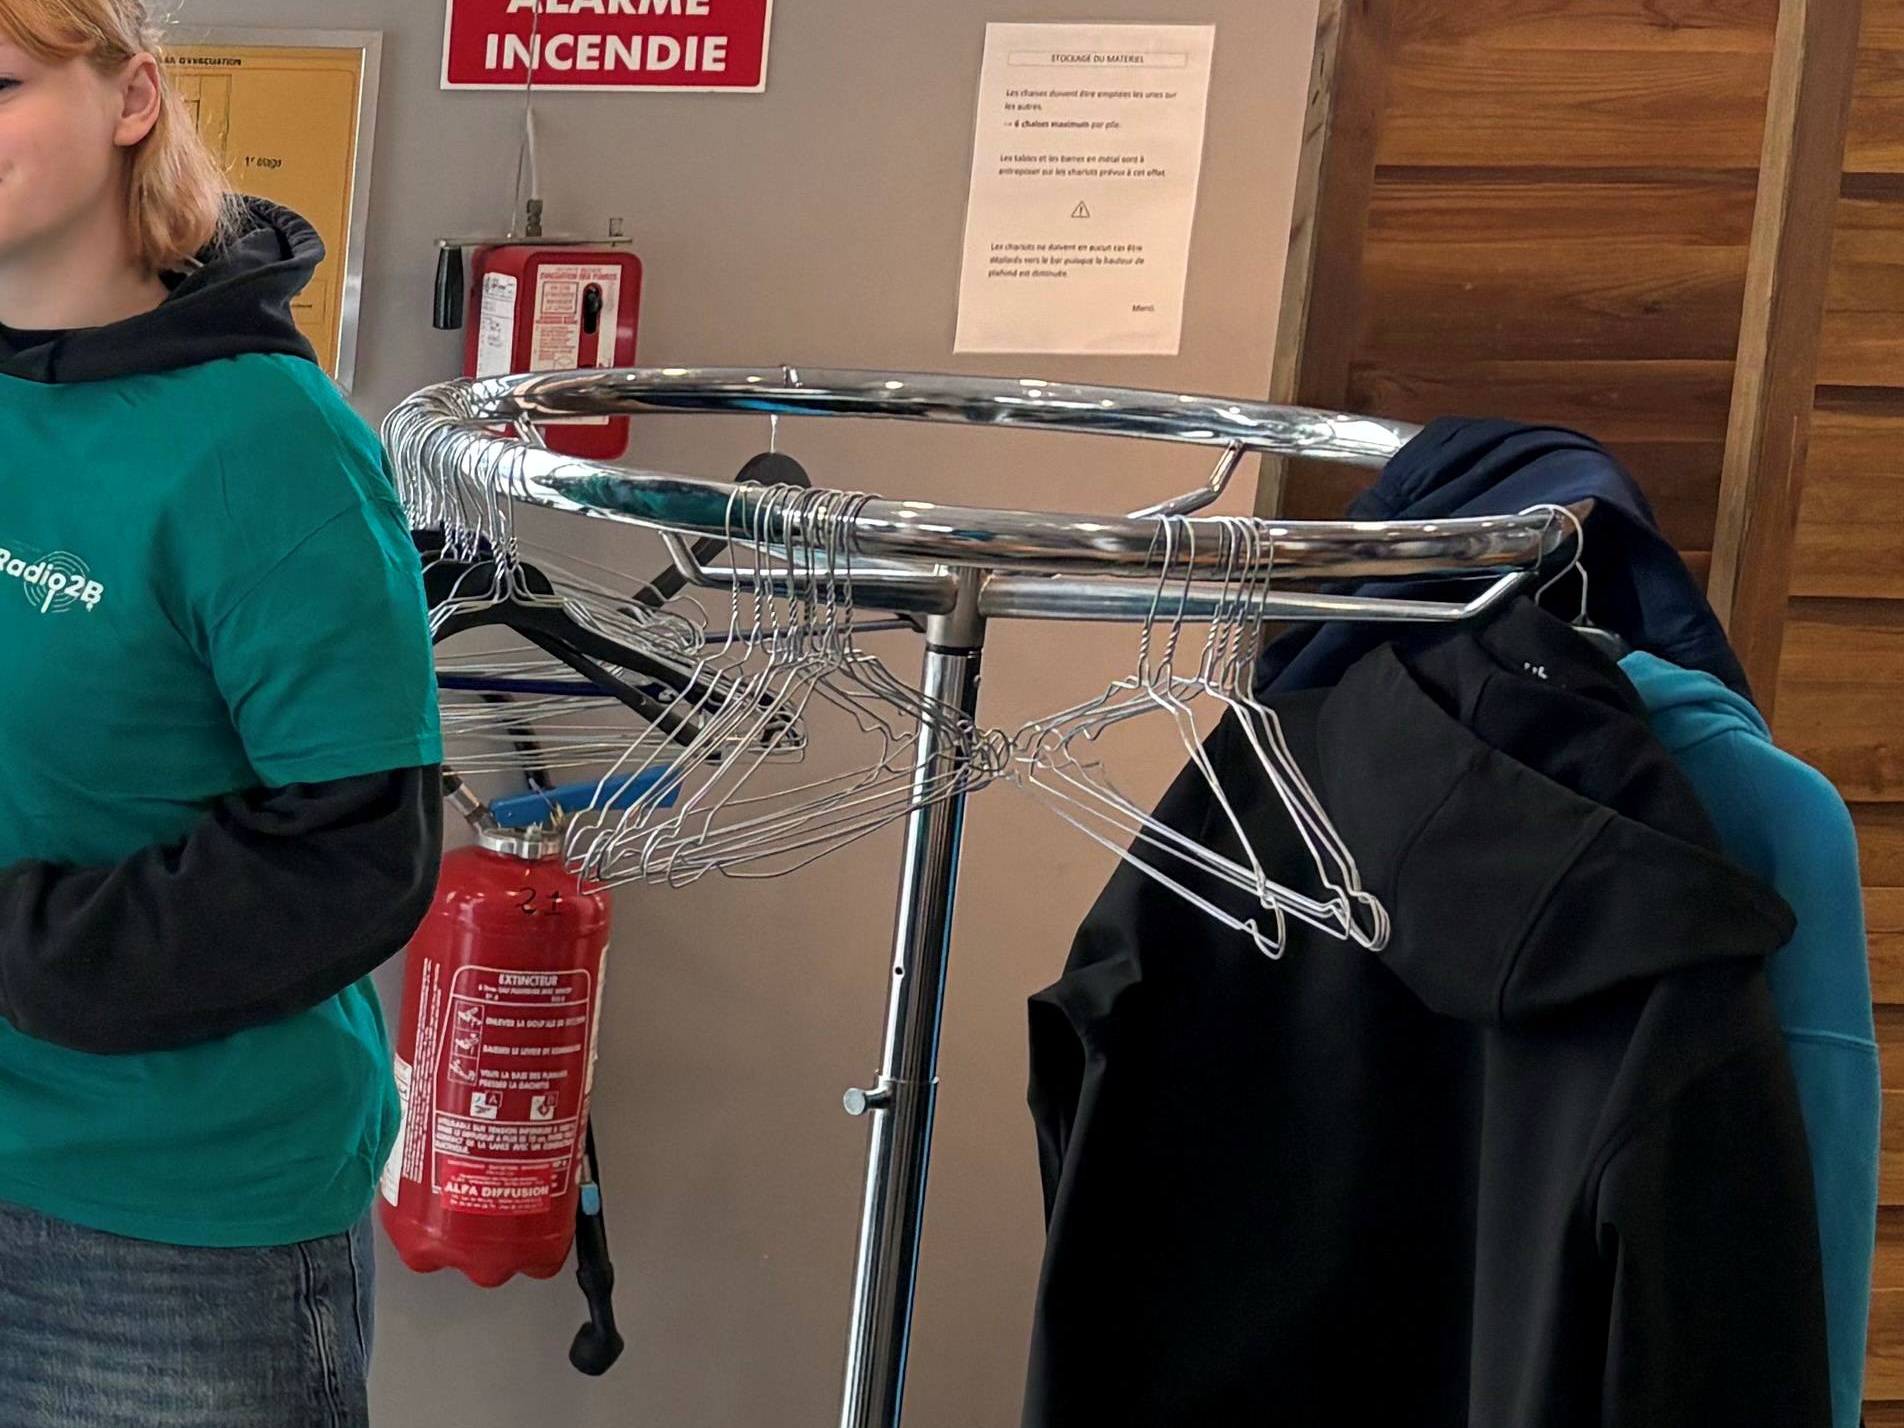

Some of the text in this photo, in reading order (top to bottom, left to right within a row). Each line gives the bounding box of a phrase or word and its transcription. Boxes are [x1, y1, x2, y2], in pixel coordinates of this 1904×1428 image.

[484, 33, 728, 72] INCENDIE
[515, 886, 563, 916] 21
[498, 973, 559, 987] EXTINCTEUR
[481, 1183, 550, 1198] DIFFUSION
